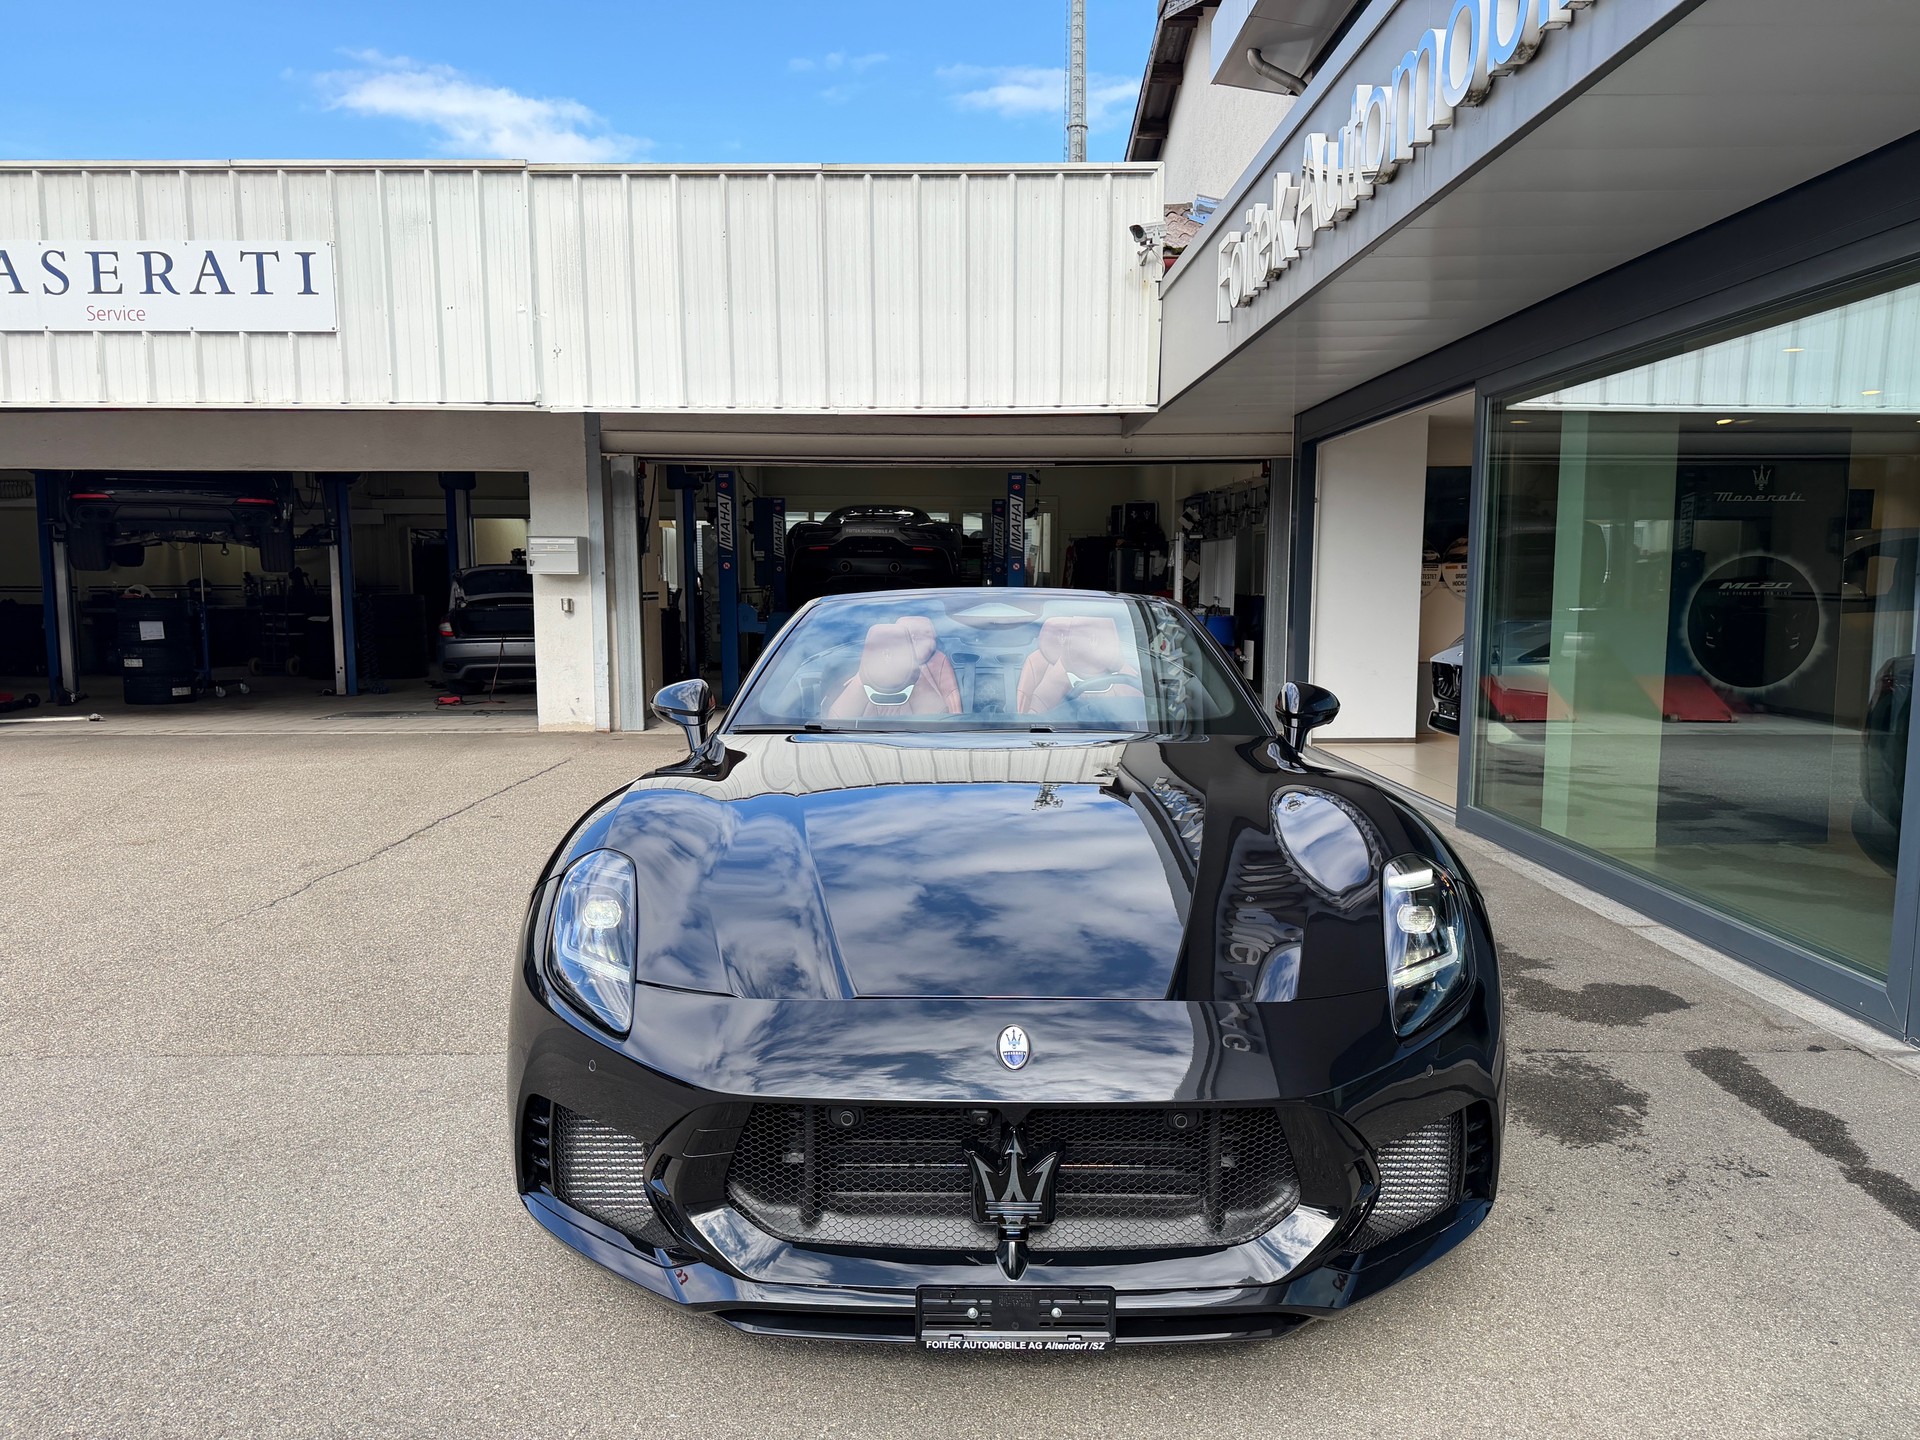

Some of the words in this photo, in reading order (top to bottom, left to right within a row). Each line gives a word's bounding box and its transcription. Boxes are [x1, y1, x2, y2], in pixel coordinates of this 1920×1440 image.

[1217, 172, 1300, 324] Foitek
[86, 305, 146, 322] Service
[1713, 491, 1806, 502] Maserati
[718, 496, 733, 549] MAHA
[773, 515, 785, 557] MAHA
[993, 516, 1004, 557] MAHA
[1010, 496, 1023, 549] MAHA
[1719, 582, 1793, 590] MC20
[926, 1341, 961, 1349] FOITEK
[962, 1341, 1026, 1350] AUTOMOBILE
[1028, 1341, 1043, 1350] AG
[1045, 1341, 1089, 1350] Altendorf
[1089, 1342, 1106, 1350] /SZ
